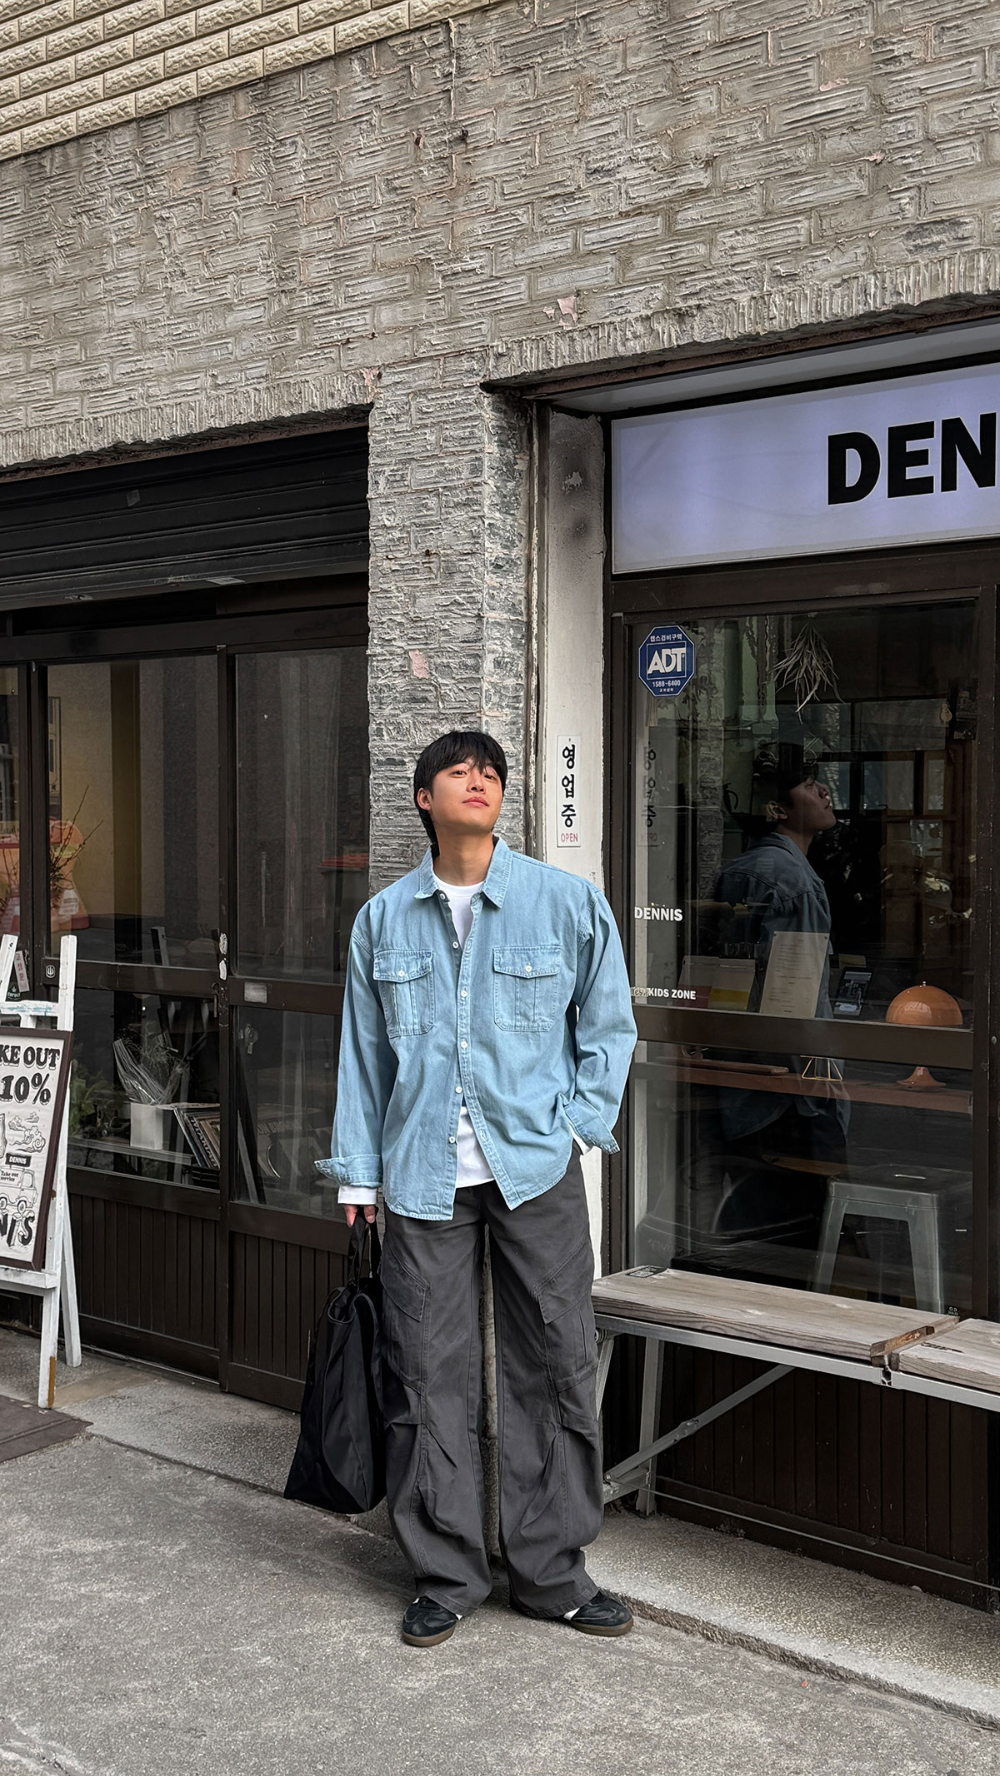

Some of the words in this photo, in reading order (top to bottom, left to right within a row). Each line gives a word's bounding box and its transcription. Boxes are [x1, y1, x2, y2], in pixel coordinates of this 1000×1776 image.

[828, 412, 996, 505] DEN
[647, 647, 686, 674] ADT
[652, 680, 681, 688] 1588-6400
[561, 744, 577, 828] 영업중
[560, 832, 578, 843] OPEN
[634, 906, 683, 922] DENNIS
[648, 987, 669, 997] KIDS
[671, 989, 697, 1000] ZONE
[23, 1046, 60, 1070] OUT
[0, 1072, 51, 1106] 10%
